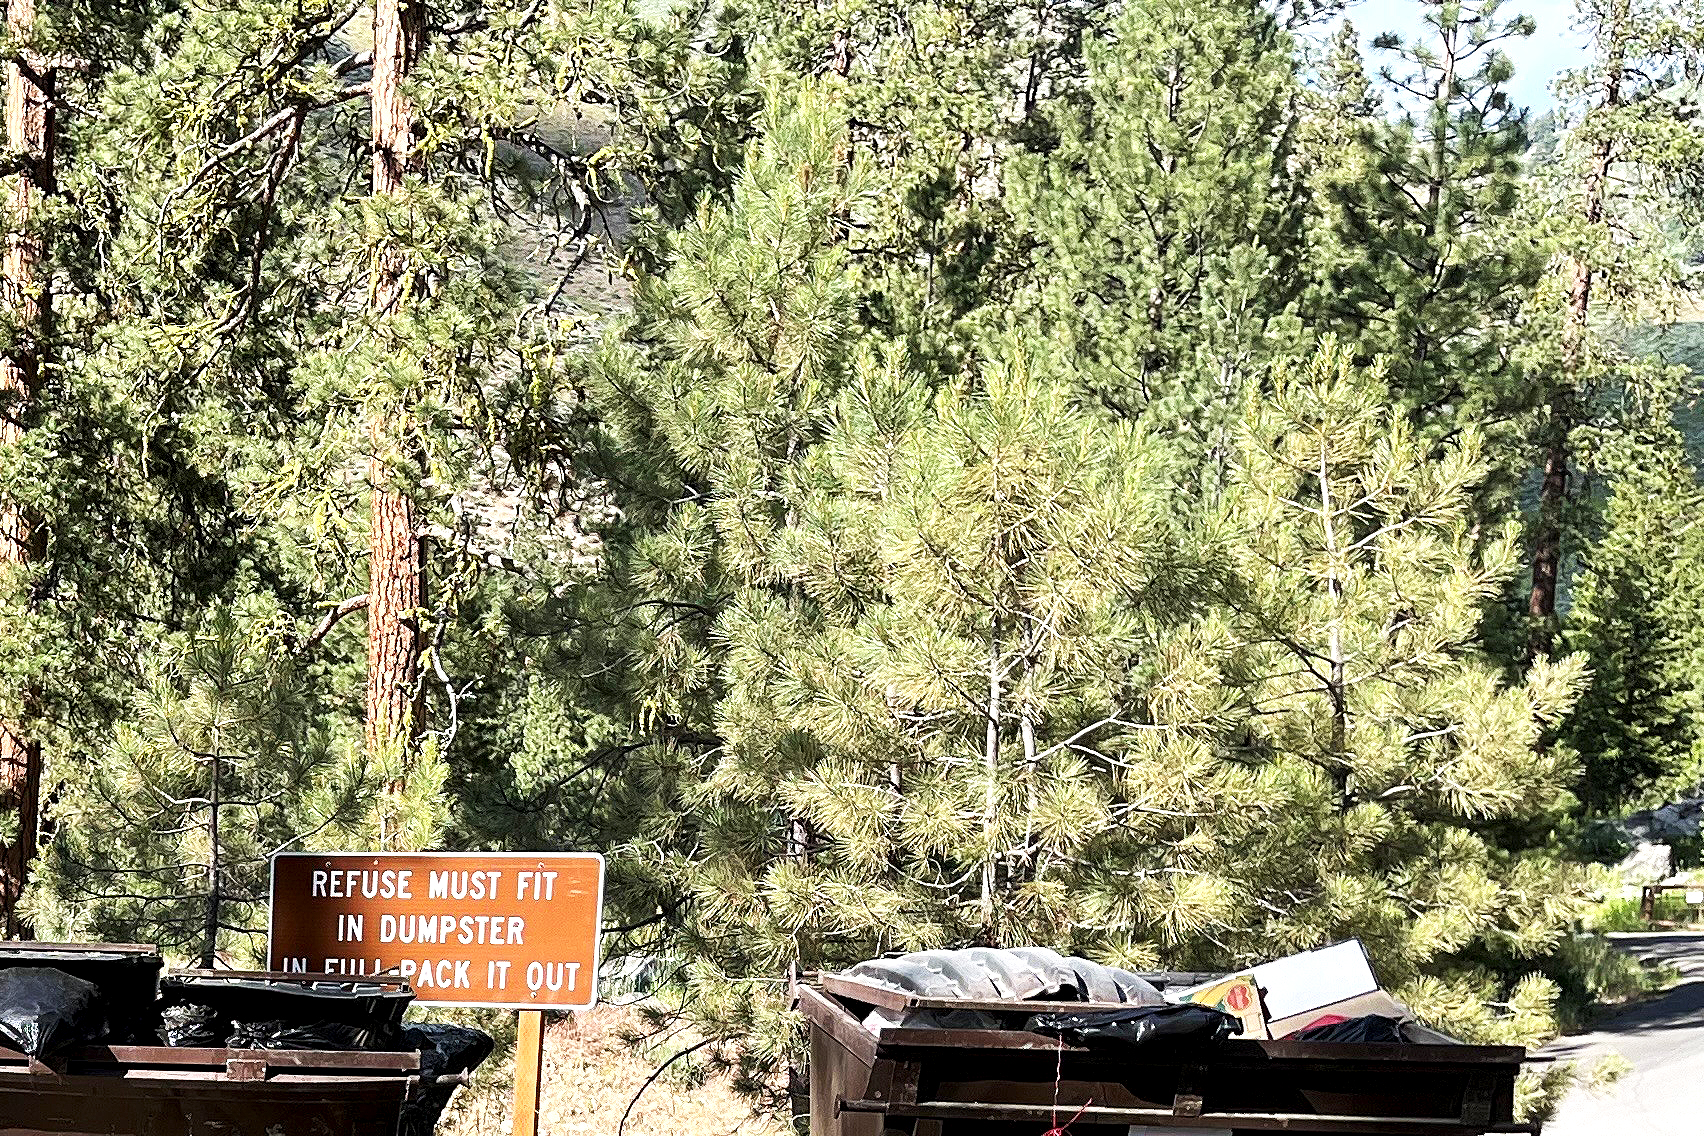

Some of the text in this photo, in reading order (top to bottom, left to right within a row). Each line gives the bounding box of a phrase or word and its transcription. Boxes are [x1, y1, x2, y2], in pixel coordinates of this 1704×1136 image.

[312, 870, 559, 901] REFUSE MUST FIT
[337, 914, 526, 945] IN DUMPSTER
[486, 960, 514, 991] IT
[525, 961, 582, 992] OUT
